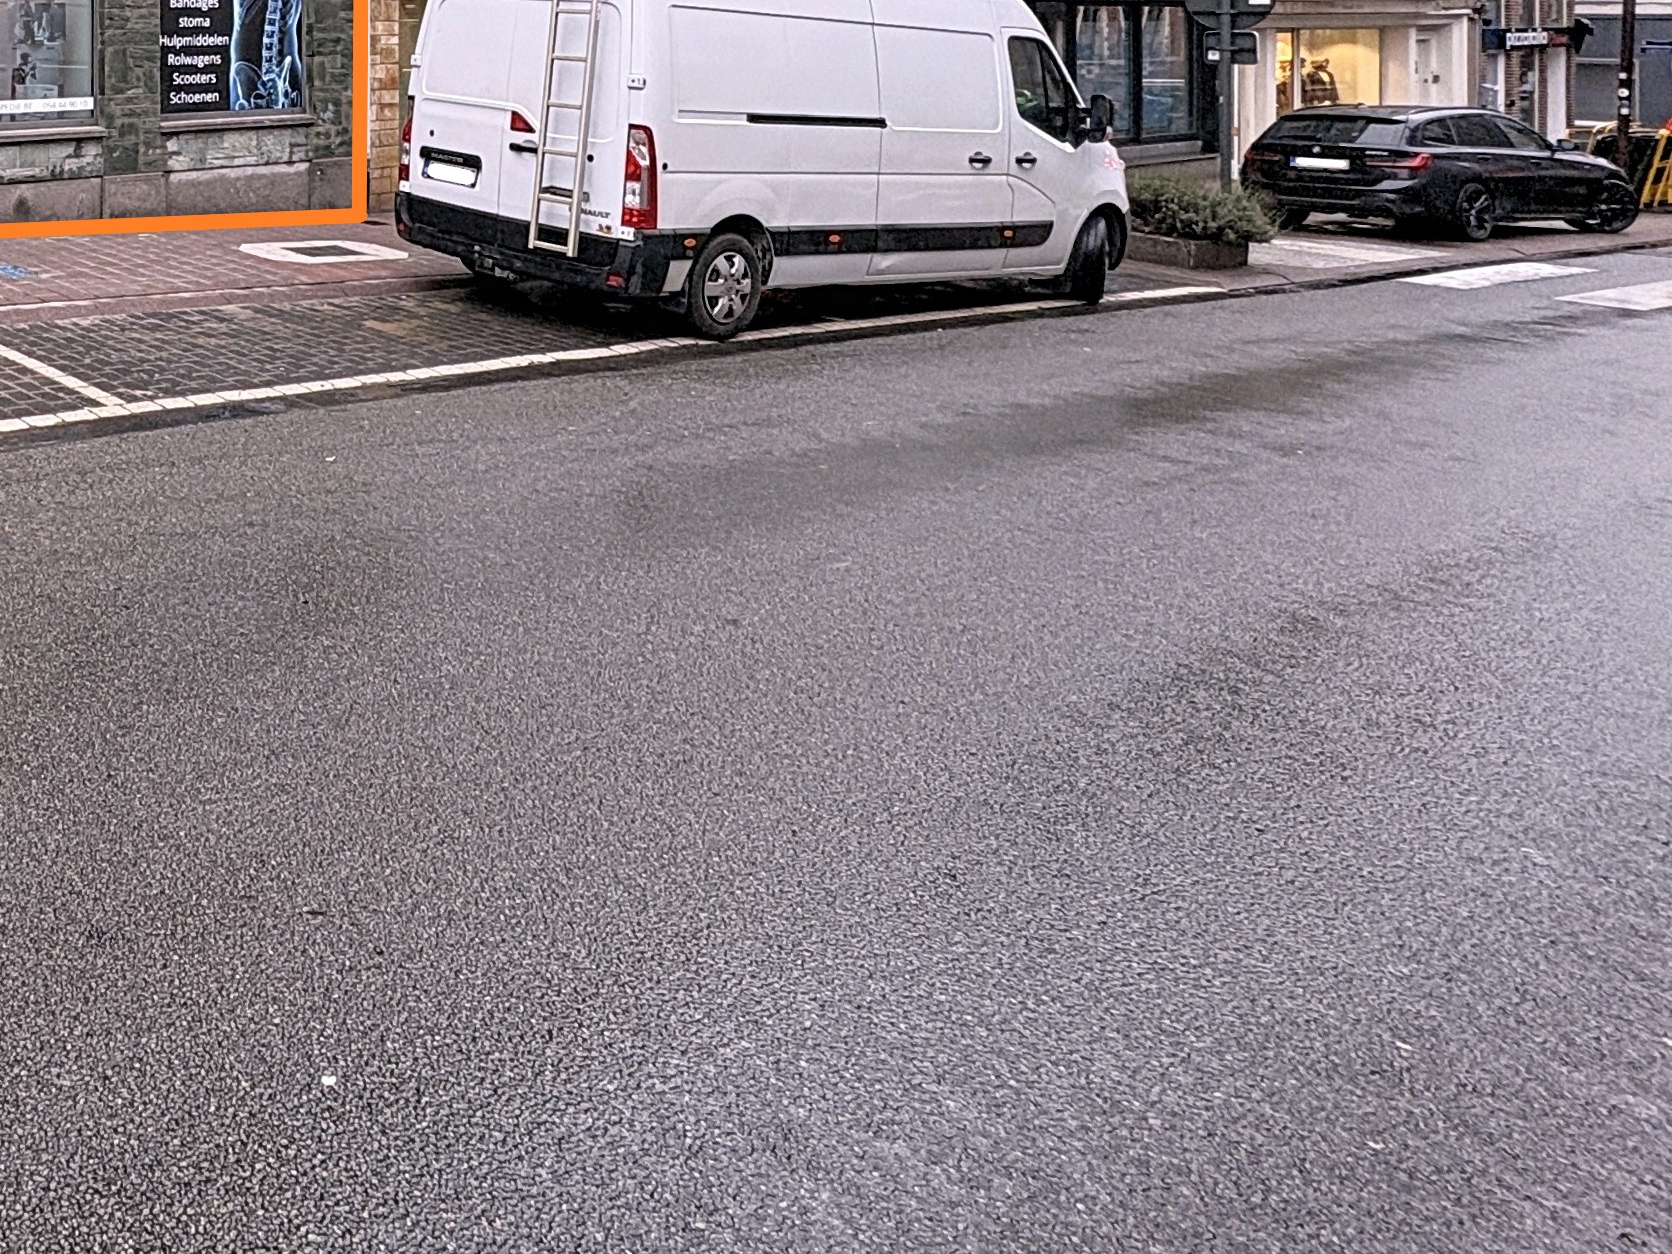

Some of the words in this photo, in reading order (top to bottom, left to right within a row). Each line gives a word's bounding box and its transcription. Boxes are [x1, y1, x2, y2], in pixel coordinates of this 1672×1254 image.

[178, 16, 210, 28] stoma
[159, 34, 229, 49] Hulpmiddelen
[167, 53, 221, 68] Rolwagens
[172, 72, 217, 85] Scooters
[169, 91, 219, 104] Schoenen
